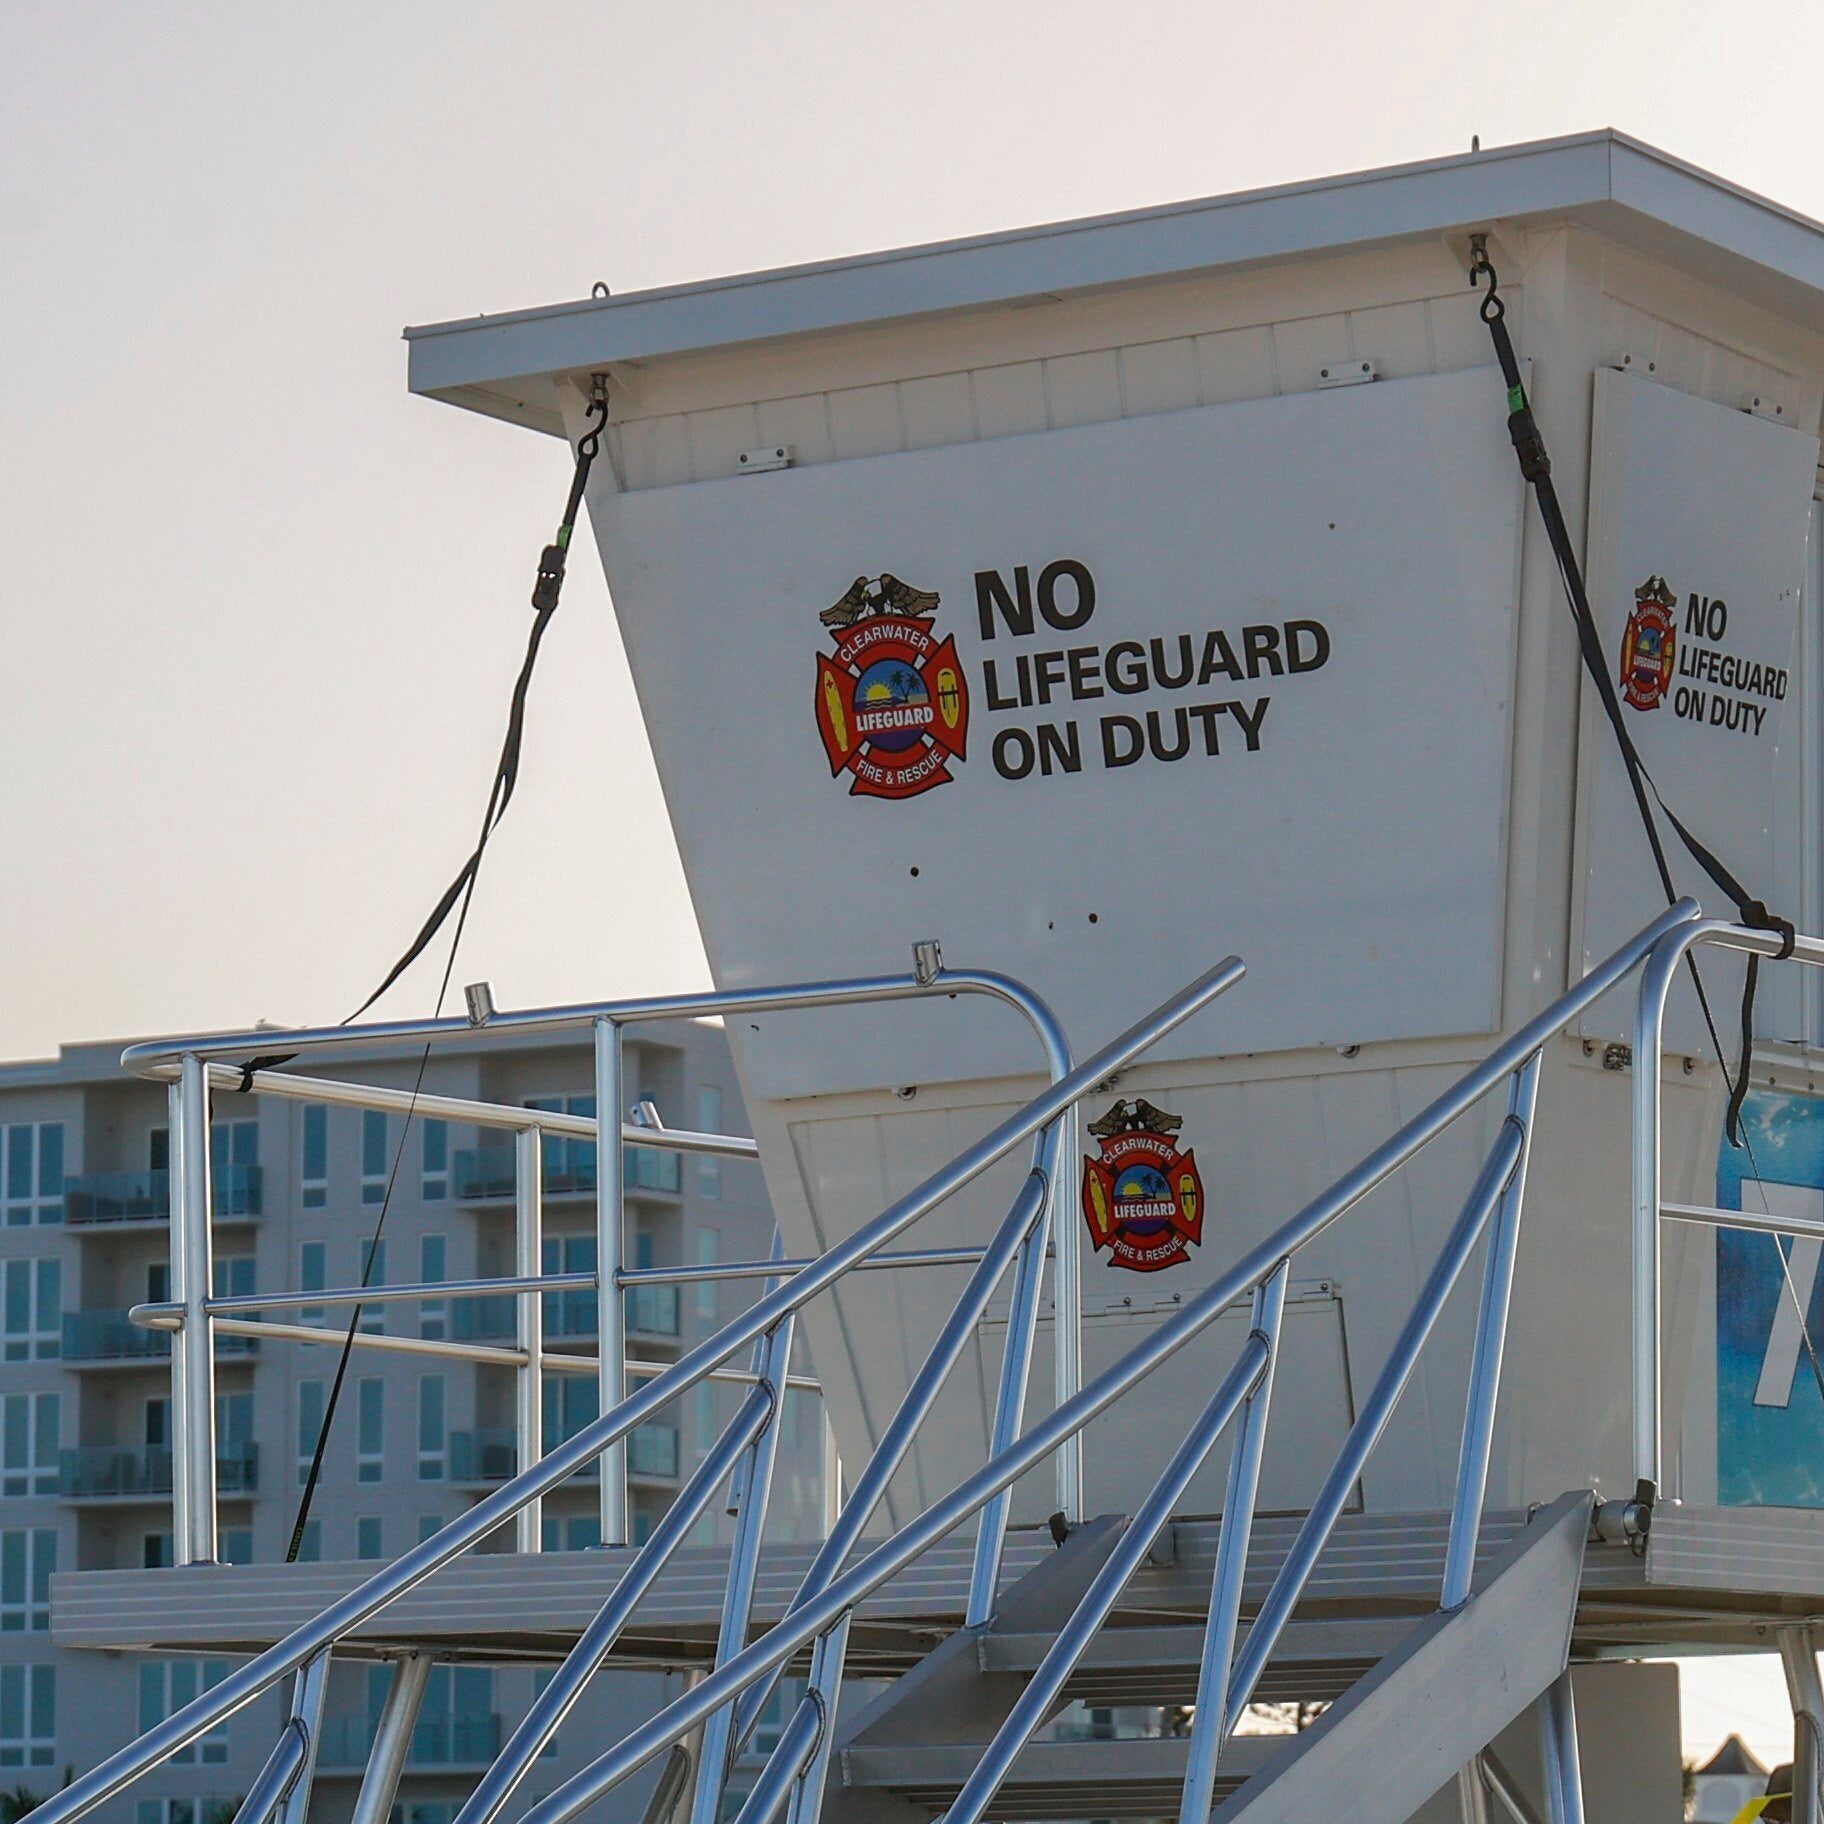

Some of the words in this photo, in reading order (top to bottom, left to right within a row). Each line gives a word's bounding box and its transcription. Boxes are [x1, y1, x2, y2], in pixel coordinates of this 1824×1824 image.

[974, 559, 1096, 640] NO
[1685, 593, 1728, 641] NO
[841, 625, 930, 662] CLEARWATER
[982, 620, 1331, 711] LIFEGUARD
[1679, 644, 1788, 700] LIFEGUARD
[856, 706, 934, 732] LIFEGUARD
[1675, 686, 1706, 722] ON
[1710, 694, 1767, 736] DUTY
[992, 720, 1082, 780] ON
[1100, 697, 1271, 769] DUTY
[856, 758, 883, 783] FIRE
[886, 771, 894, 785] &
[898, 750, 943, 785] RESCUE
[1103, 1138, 1174, 1164] CLEARWATER
[1114, 1203, 1176, 1219] LIFEGUARD
[1114, 1240, 1134, 1260] FIRE
[1137, 1250, 1143, 1261] &
[1146, 1237, 1183, 1262] RESCUE
[1740, 1176, 1824, 1409] 7
